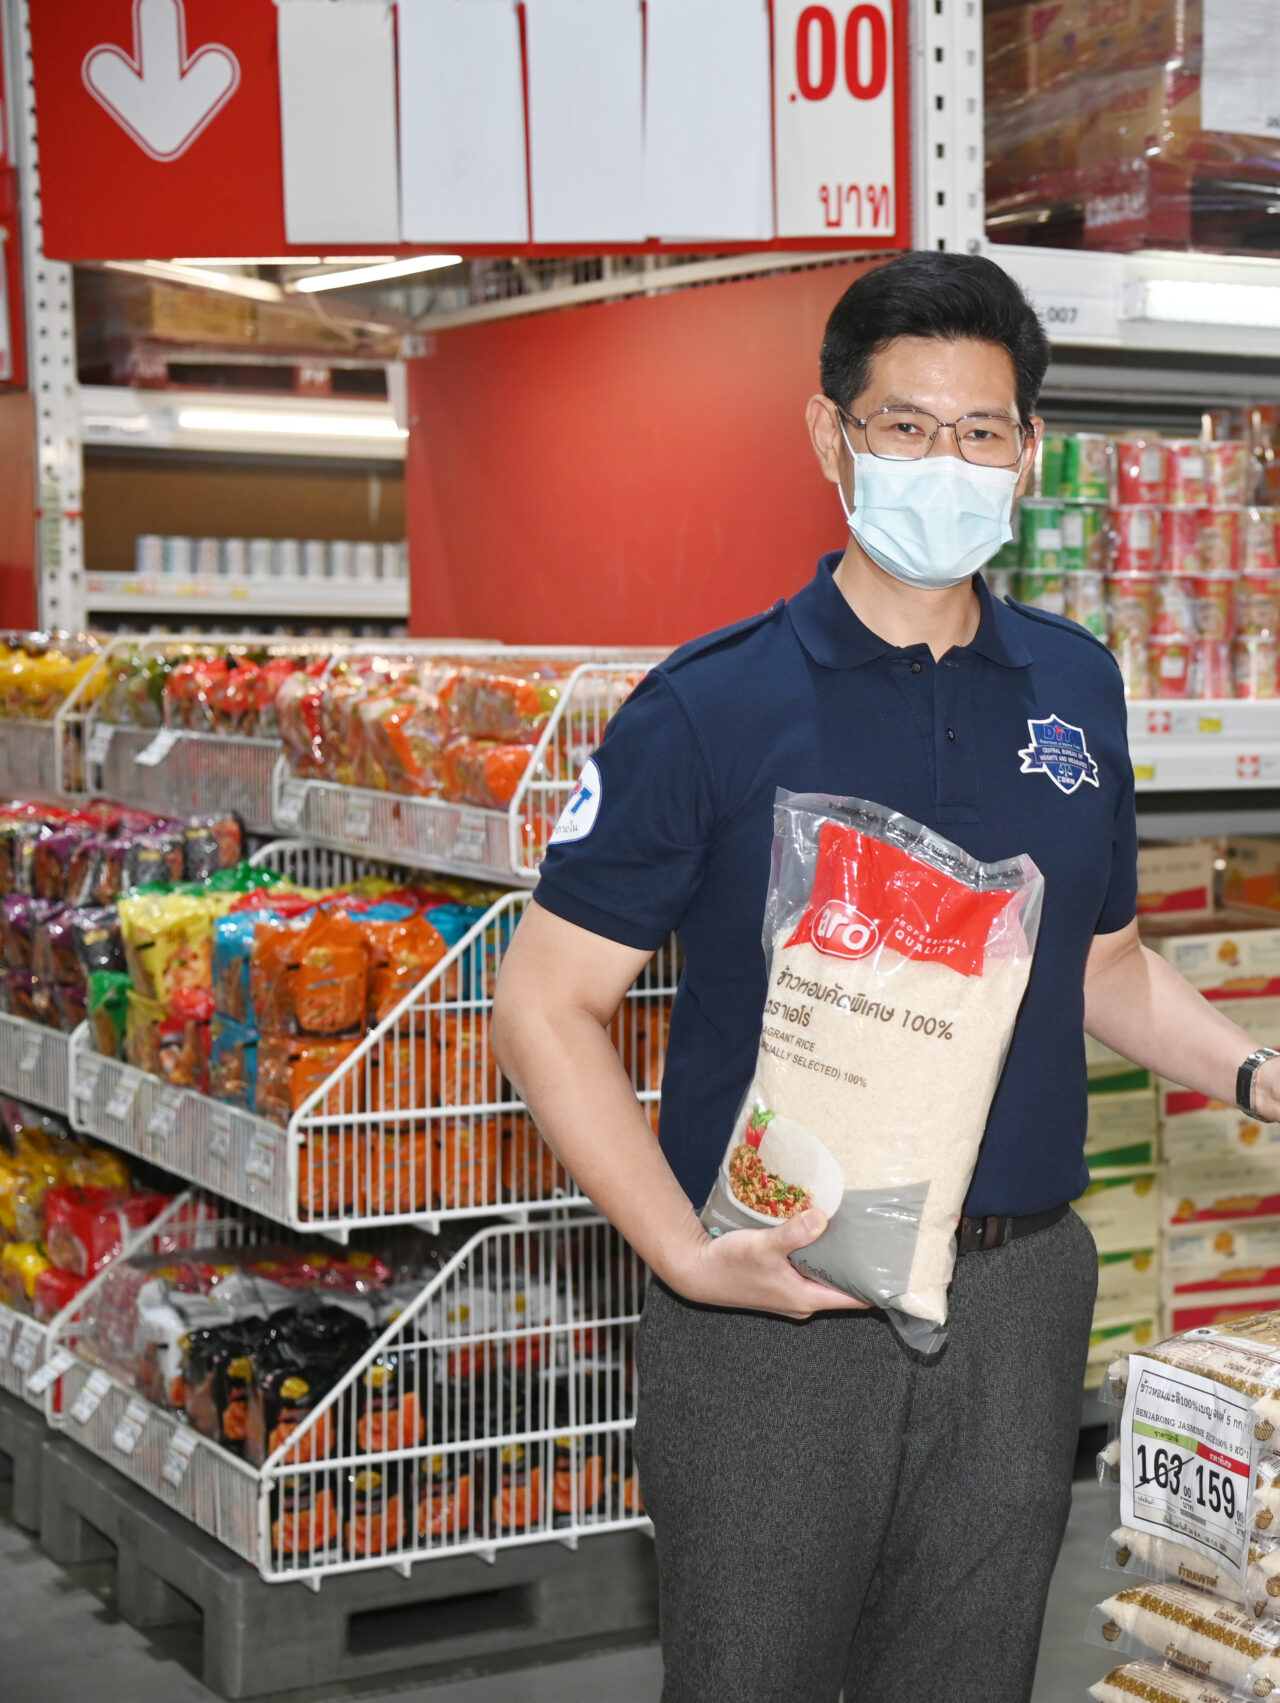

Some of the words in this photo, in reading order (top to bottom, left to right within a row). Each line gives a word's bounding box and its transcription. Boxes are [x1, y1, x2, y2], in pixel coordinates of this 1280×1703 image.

[819, 184, 889, 228] บาท
[817, 908, 871, 950] aro
[893, 917, 967, 949] PROFESSIONAL
[895, 929, 955, 954] QUALITY
[777, 965, 896, 1022] ข้าวหอมคัดพิเศษ
[902, 1010, 953, 1040] 100%
[797, 1037, 816, 1052] RICE
[792, 1055, 841, 1080] SELECTED)
[843, 1073, 867, 1088] 100%
[1136, 1407, 1176, 1427] BENJARONG
[1178, 1419, 1205, 1438] JASMINE
[1137, 1444, 1183, 1496] 163
[1196, 1464, 1235, 1520] 159
